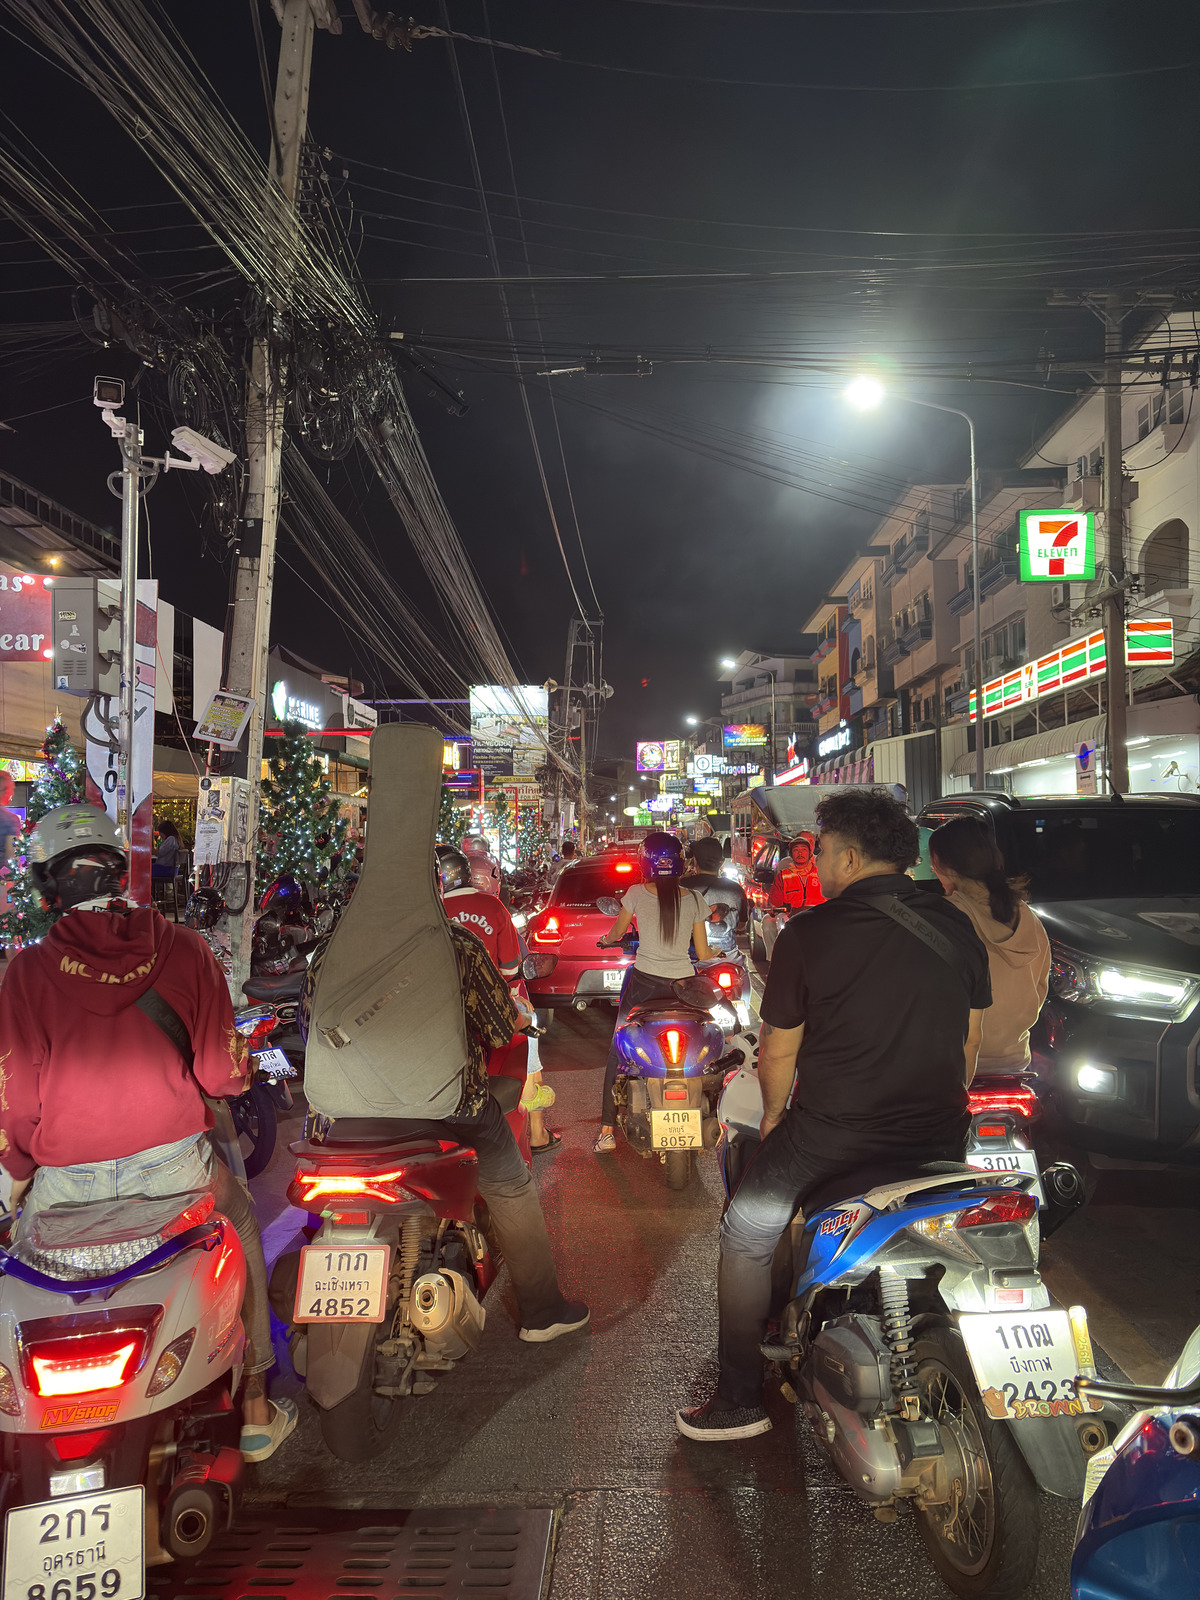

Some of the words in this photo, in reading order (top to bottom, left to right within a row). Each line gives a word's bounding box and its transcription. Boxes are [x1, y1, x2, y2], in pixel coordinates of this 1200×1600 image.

[288, 696, 320, 723] MARINE
[721, 764, 746, 776] Dragon
[747, 763, 759, 774] Bar
[684, 797, 711, 806] TATTOO
[60, 955, 93, 977] MC
[660, 1135, 696, 1147] 8057
[324, 1252, 368, 1271] 1กภ
[314, 1276, 370, 1291] ฉะเชิงเทรา
[308, 1298, 370, 1316] 4852
[1078, 1337, 1091, 1364] 2568
[1009, 1356, 1053, 1374] บึงกาฬ
[1002, 1379, 1079, 1408] 2423
[1012, 1398, 1084, 1419] BROWN
[39, 1503, 111, 1544] 2กร
[42, 1541, 106, 1577] อุดรธานี
[27, 1568, 122, 1600] 8659
